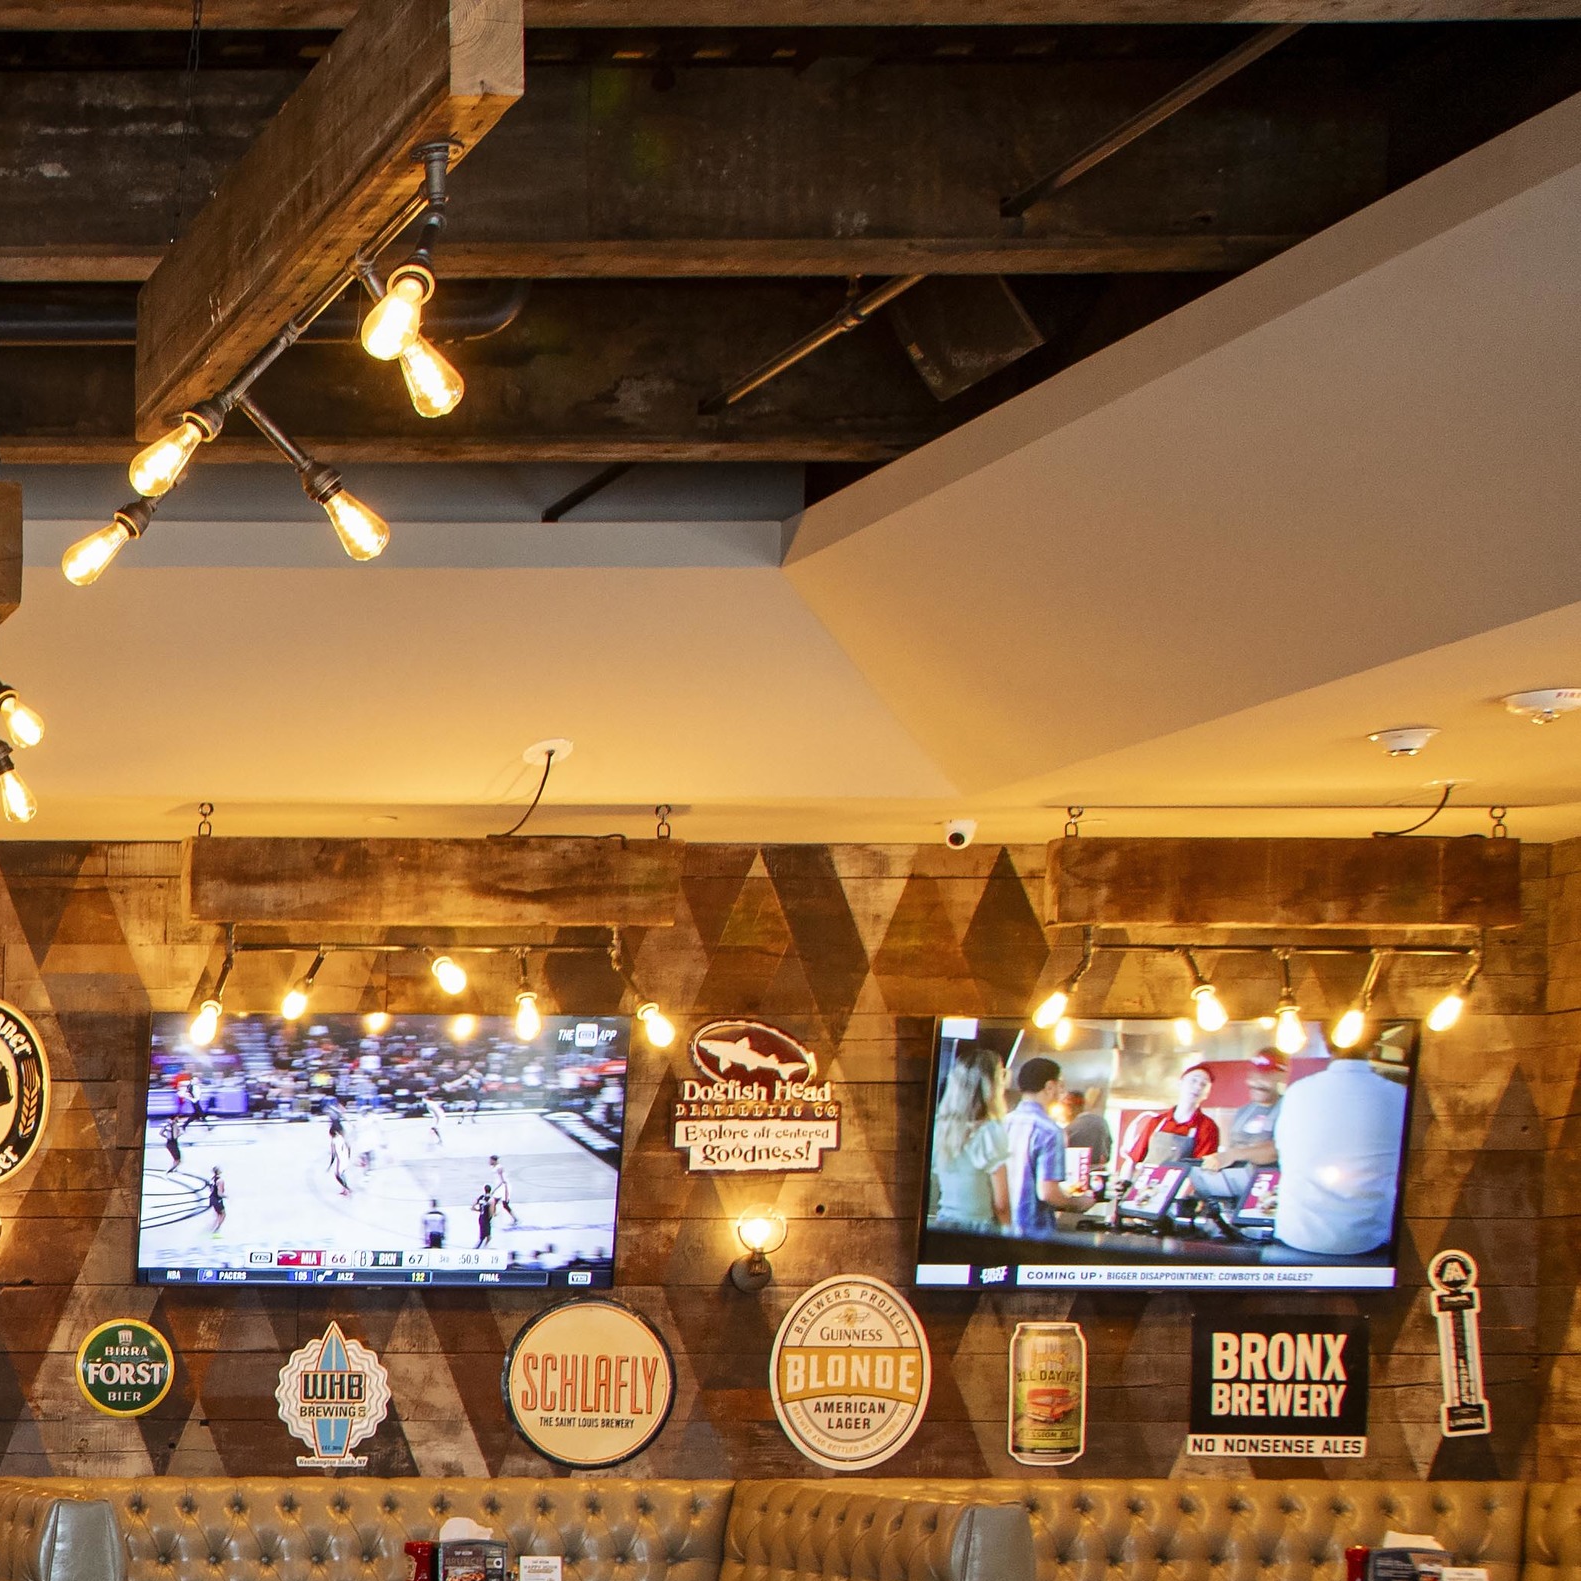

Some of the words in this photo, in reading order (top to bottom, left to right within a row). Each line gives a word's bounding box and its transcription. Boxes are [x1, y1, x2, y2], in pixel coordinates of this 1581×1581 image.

[558, 1030, 575, 1041] THE
[598, 1030, 617, 1041] APP
[683, 1080, 767, 1101] Dogfish
[773, 1080, 832, 1102] Head
[675, 1103, 803, 1117] DISTILLING
[685, 1124, 749, 1142] Explore
[753, 1126, 829, 1139] off-centered
[701, 1141, 811, 1165] goodness!
[301, 1252, 318, 1265] MIA
[331, 1254, 347, 1264] 66
[379, 1252, 397, 1265] BKN
[409, 1255, 424, 1264] 67
[166, 1270, 181, 1280] NBA
[219, 1271, 247, 1280] PACERS
[337, 1271, 354, 1282] JAZZ
[411, 1273, 425, 1282] 132
[479, 1273, 500, 1282] FINAL
[1027, 1272, 1076, 1280] COMING
[1080, 1272, 1097, 1281] UP
[1107, 1272, 1137, 1282] BIGGER
[1140, 1272, 1216, 1282] DISAPPOINTMENT:
[1218, 1272, 1261, 1282] COWBOYS
[1262, 1272, 1276, 1282] OR
[1277, 1272, 1313, 1283] EAGLES?
[794, 1289, 851, 1335] BREWERS
[860, 1289, 910, 1337] PROJECT
[820, 1326, 883, 1341] GUINNESS
[105, 1345, 148, 1356] BIRRA
[1211, 1332, 1348, 1381] BRONX
[87, 1362, 166, 1385] FORST
[785, 1354, 916, 1396] BLONDE
[1039, 1370, 1063, 1381] DAY
[303, 1374, 363, 1399] WHB
[521, 1352, 659, 1414] SCHLAFLY
[108, 1391, 141, 1402] BIER
[1211, 1382, 1347, 1417] BREWERY
[299, 1406, 356, 1417] BREWING
[814, 1402, 886, 1414] AMERICAN
[540, 1416, 555, 1427] THE
[555, 1417, 576, 1427] SAINT
[578, 1417, 599, 1428] LOUIS
[601, 1418, 635, 1429] BREWERY
[828, 1417, 871, 1429] LAGER
[1192, 1438, 1216, 1452] NO
[1224, 1438, 1314, 1453] NONSENSE
[1322, 1440, 1362, 1454] ALES
